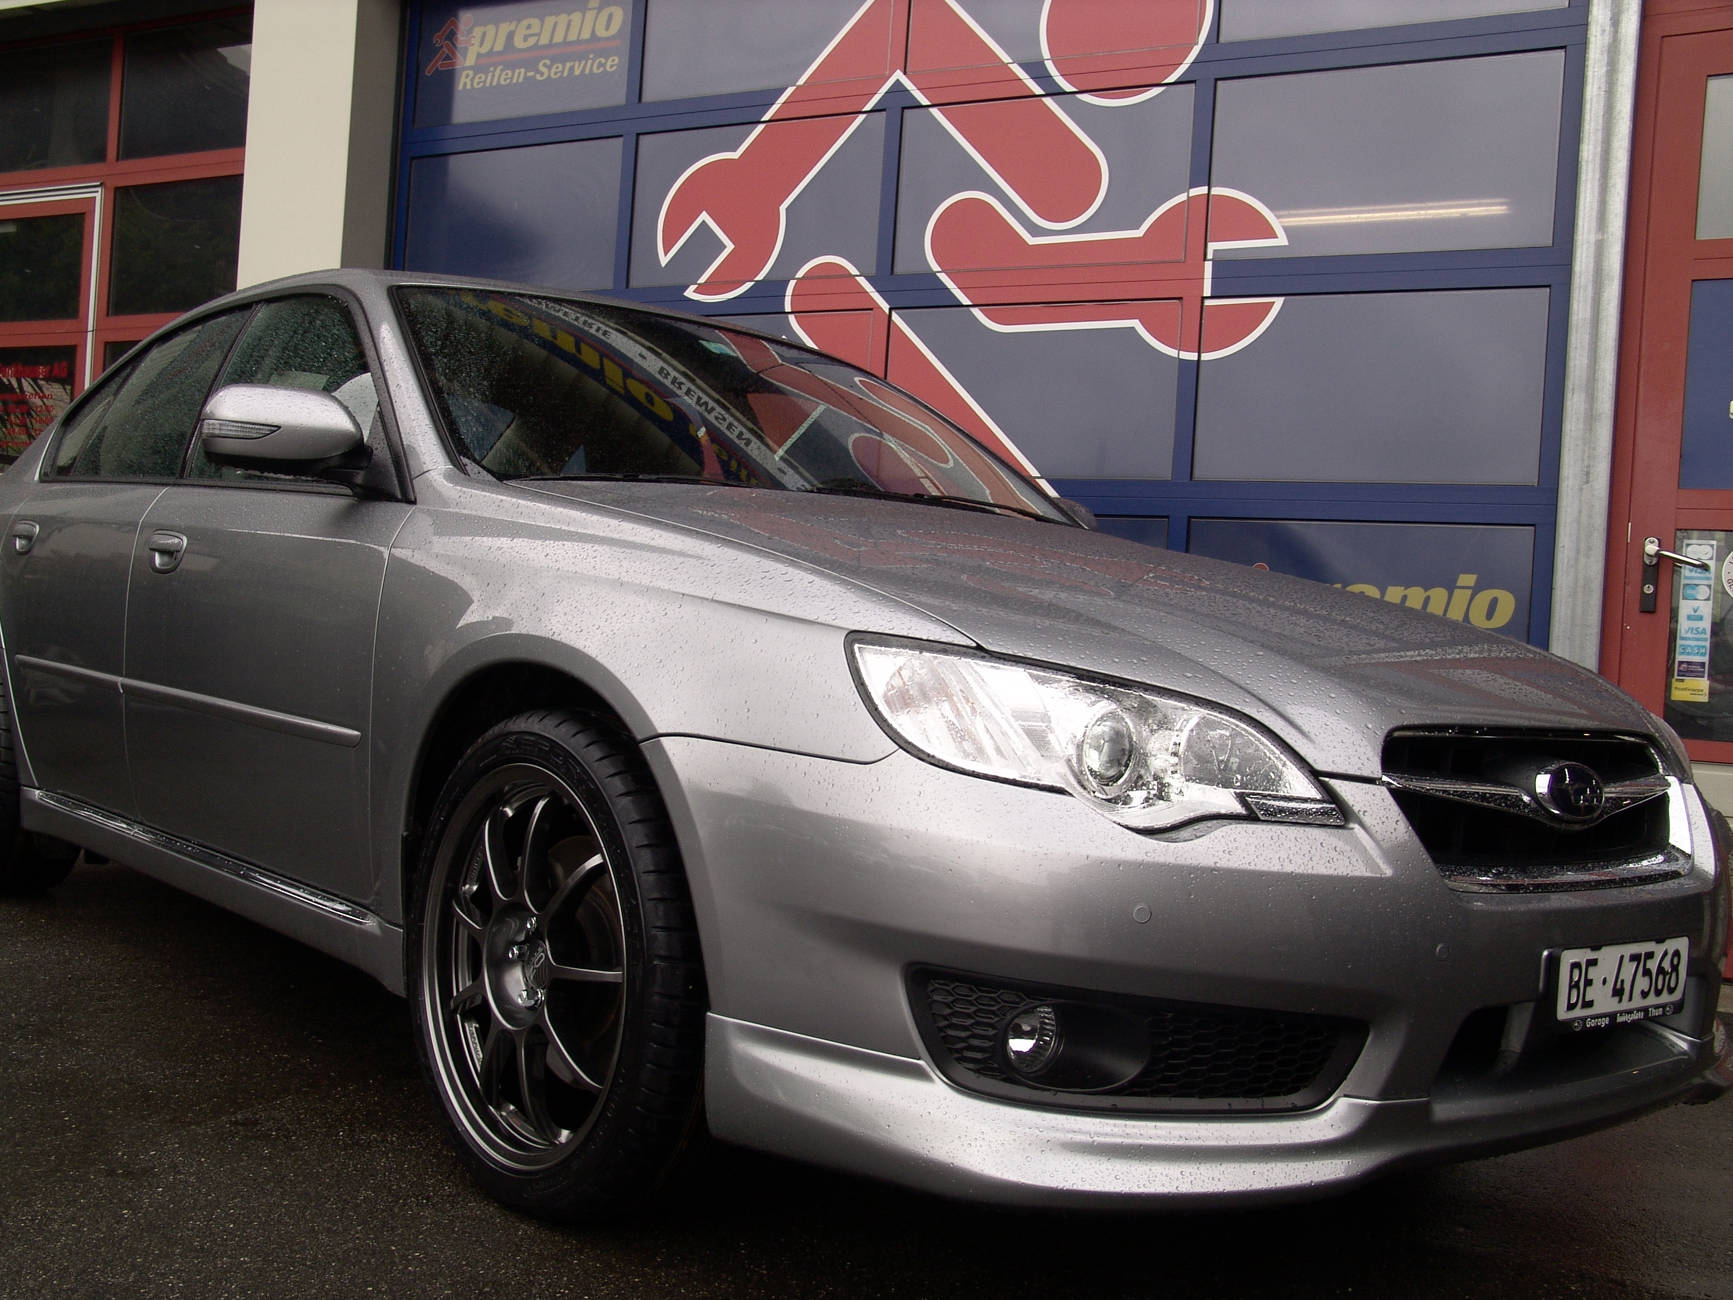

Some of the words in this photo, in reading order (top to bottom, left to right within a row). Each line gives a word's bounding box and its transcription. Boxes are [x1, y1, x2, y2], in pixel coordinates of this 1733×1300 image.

[464, 0, 624, 66] premio
[457, 54, 619, 90] Reifen-Service
[1685, 626, 1707, 635] VISA
[1586, 1016, 1610, 1028] Garage
